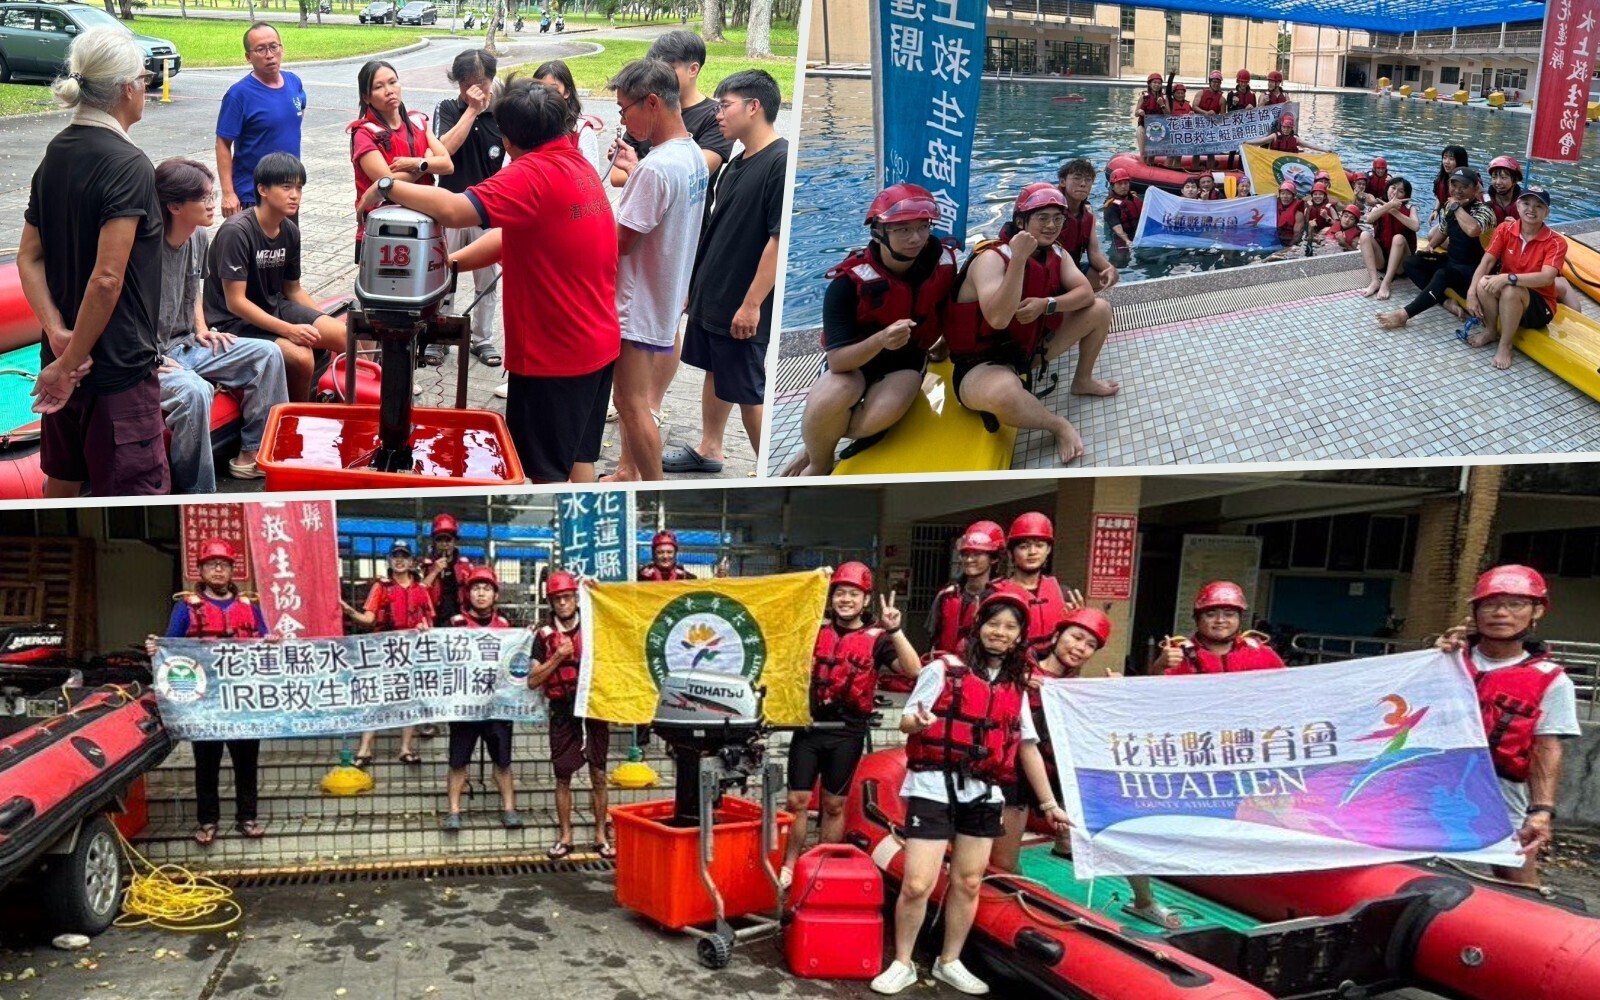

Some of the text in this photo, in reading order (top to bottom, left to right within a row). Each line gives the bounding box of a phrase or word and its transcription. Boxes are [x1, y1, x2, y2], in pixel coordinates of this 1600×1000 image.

[1167, 105, 1283, 131] 花蓮縣水上救生協會
[1169, 123, 1272, 146] IRB救生艇證照訓
[379, 244, 411, 267] 18
[259, 501, 306, 640] 救生協會
[212, 633, 501, 678] 花蓮縣水上救生協會
[220, 667, 498, 711] IRB救生艇證照訓練
[688, 684, 745, 698] TOHATSU
[1108, 720, 1338, 768] 花蓮縣體育會
[1115, 767, 1310, 800] HUALIEN
